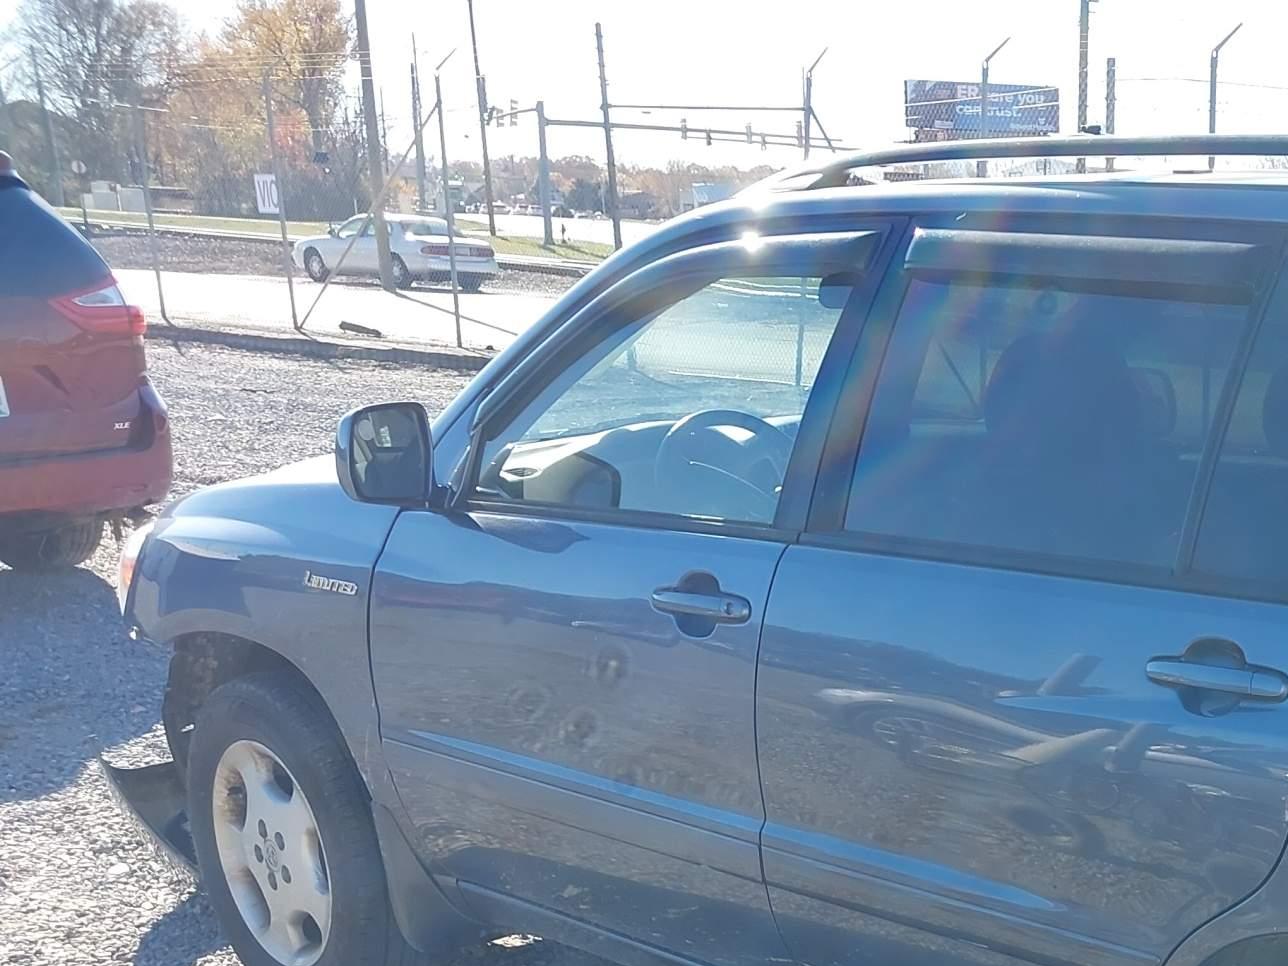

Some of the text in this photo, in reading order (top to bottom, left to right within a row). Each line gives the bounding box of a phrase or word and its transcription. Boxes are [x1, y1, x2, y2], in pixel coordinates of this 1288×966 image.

[957, 84, 979, 98] ER
[1017, 93, 1045, 106] you
[956, 105, 982, 116] can
[113, 421, 131, 430] XLE
[304, 570, 358, 596] LIMITED
